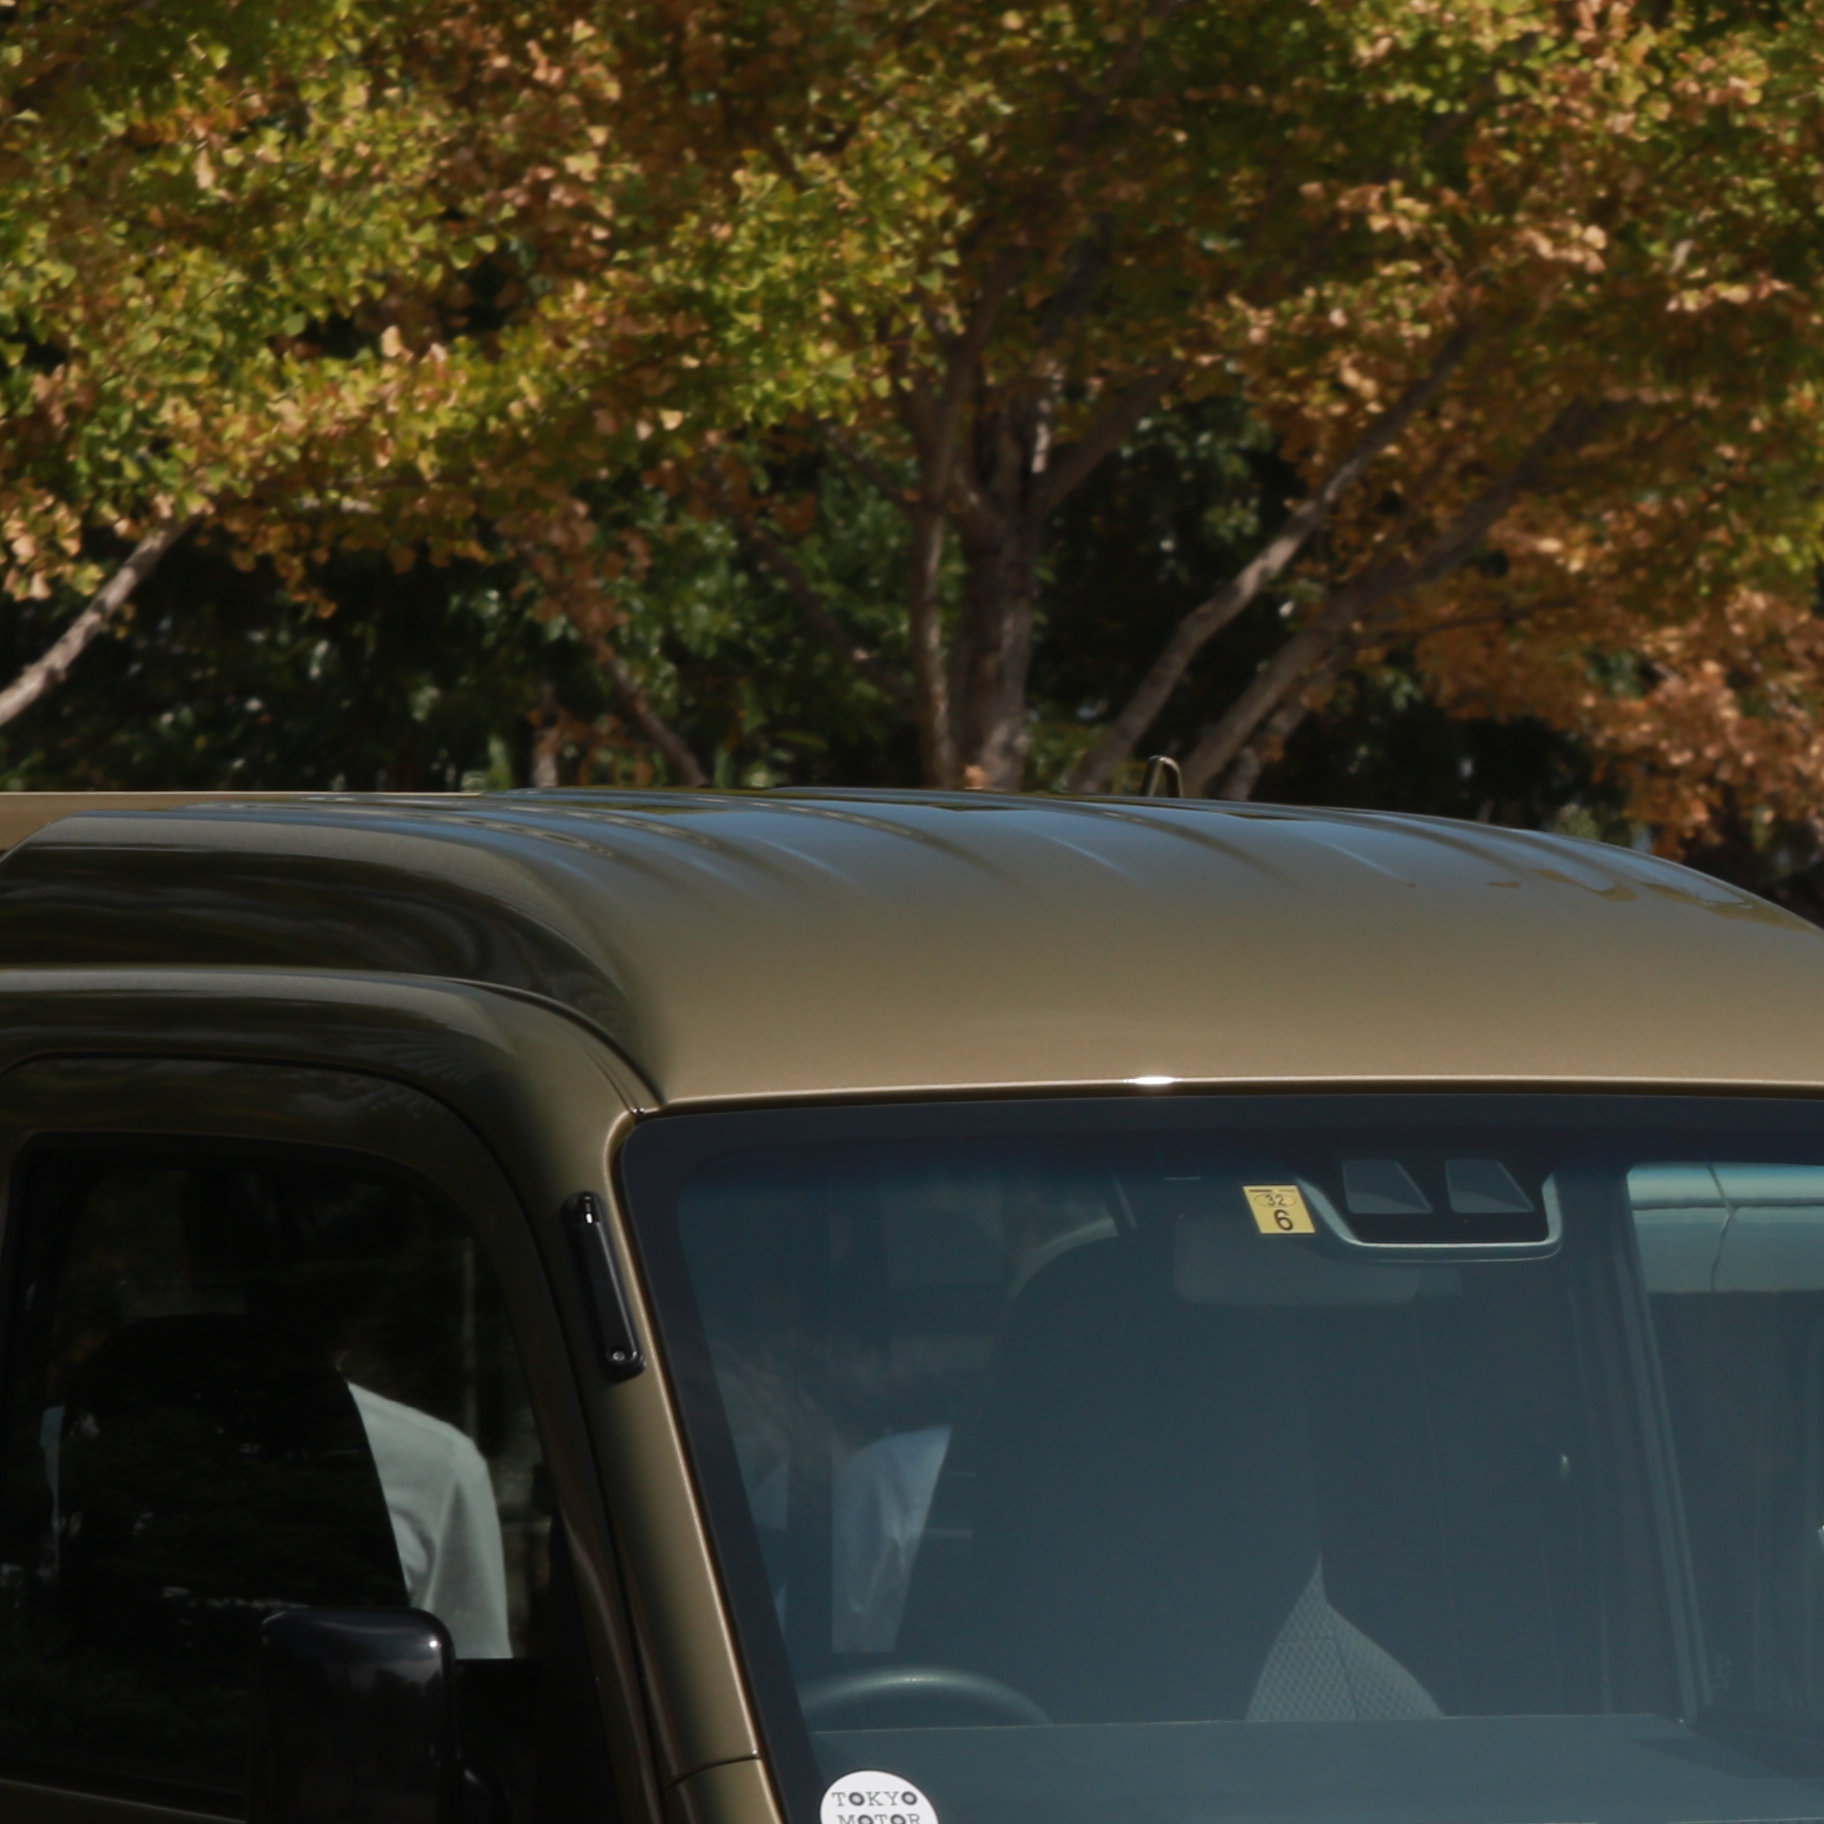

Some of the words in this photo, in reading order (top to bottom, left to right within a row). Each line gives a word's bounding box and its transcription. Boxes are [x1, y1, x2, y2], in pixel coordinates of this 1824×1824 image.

[1265, 1194, 1286, 1207] 32
[1274, 1209, 1293, 1231] 6
[832, 1791, 918, 1807] TOKYO
